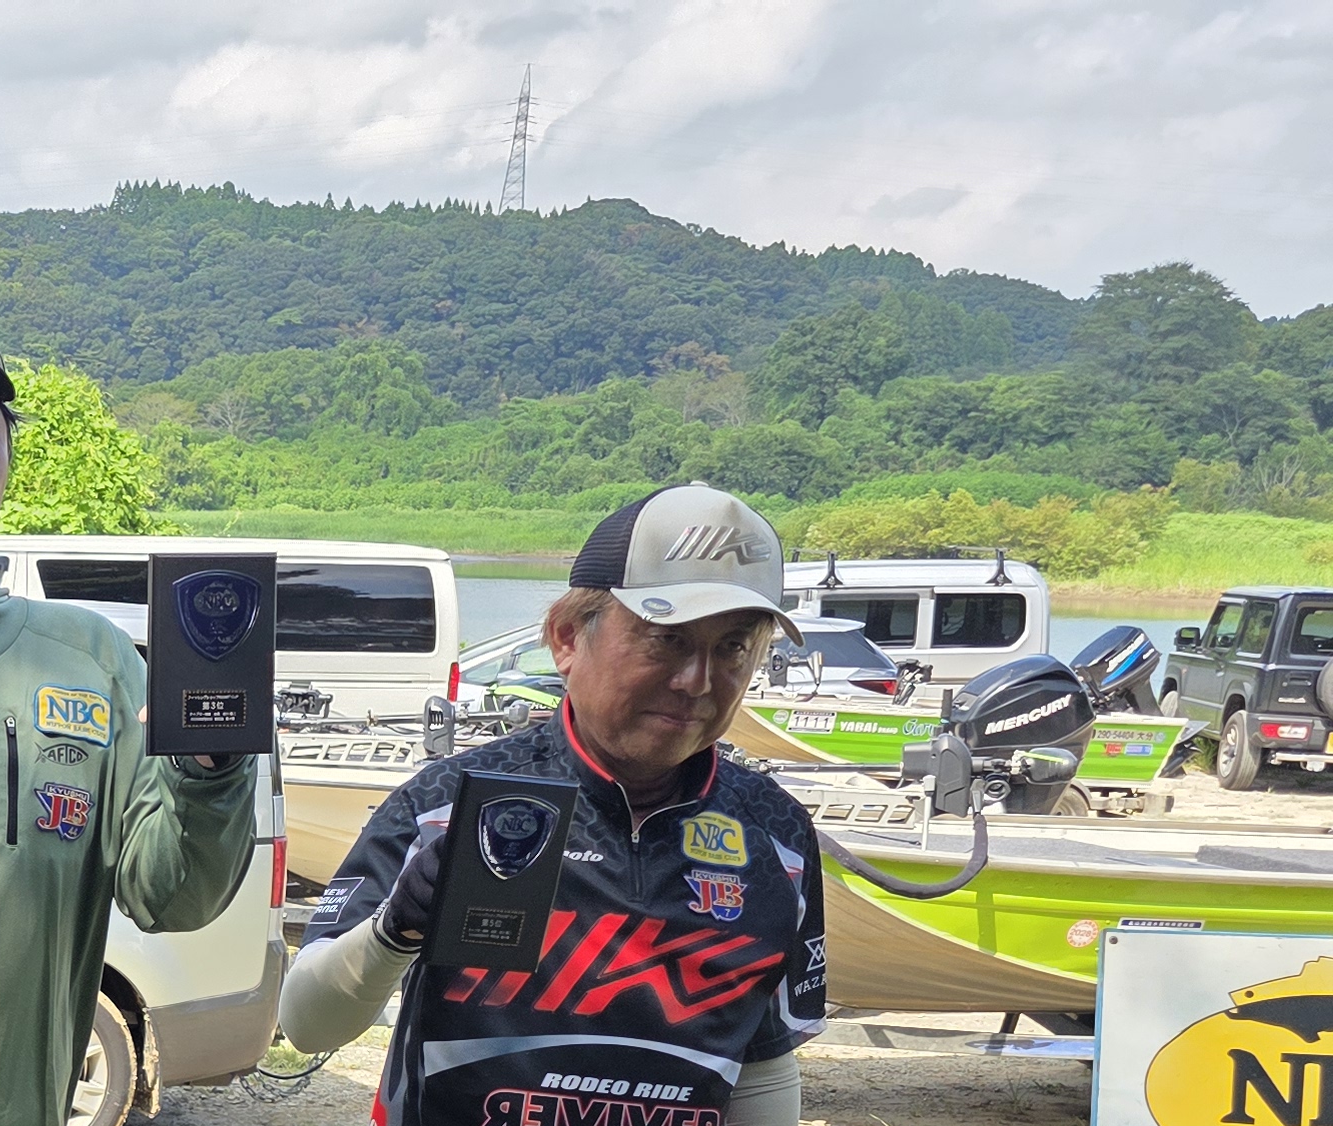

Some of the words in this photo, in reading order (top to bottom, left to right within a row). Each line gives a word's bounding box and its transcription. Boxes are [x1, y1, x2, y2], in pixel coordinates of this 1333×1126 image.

[45, 695, 105, 732] NBC
[202, 701, 225, 711] 第3位
[984, 694, 1072, 735] MERCURY
[793, 715, 830, 729] 1111
[1136, 731, 1154, 741] 大分
[47, 745, 84, 764] AFTCO
[48, 787, 87, 801] KYUSHU
[37, 794, 90, 830] JB
[500, 816, 533, 832] NBC
[687, 821, 739, 855] NBC
[688, 880, 744, 913] JB
[724, 908, 731, 917] 7
[1069, 928, 1092, 938] 2028
[541, 1072, 631, 1097] RODEO
[633, 1082, 694, 1102] RIDE
